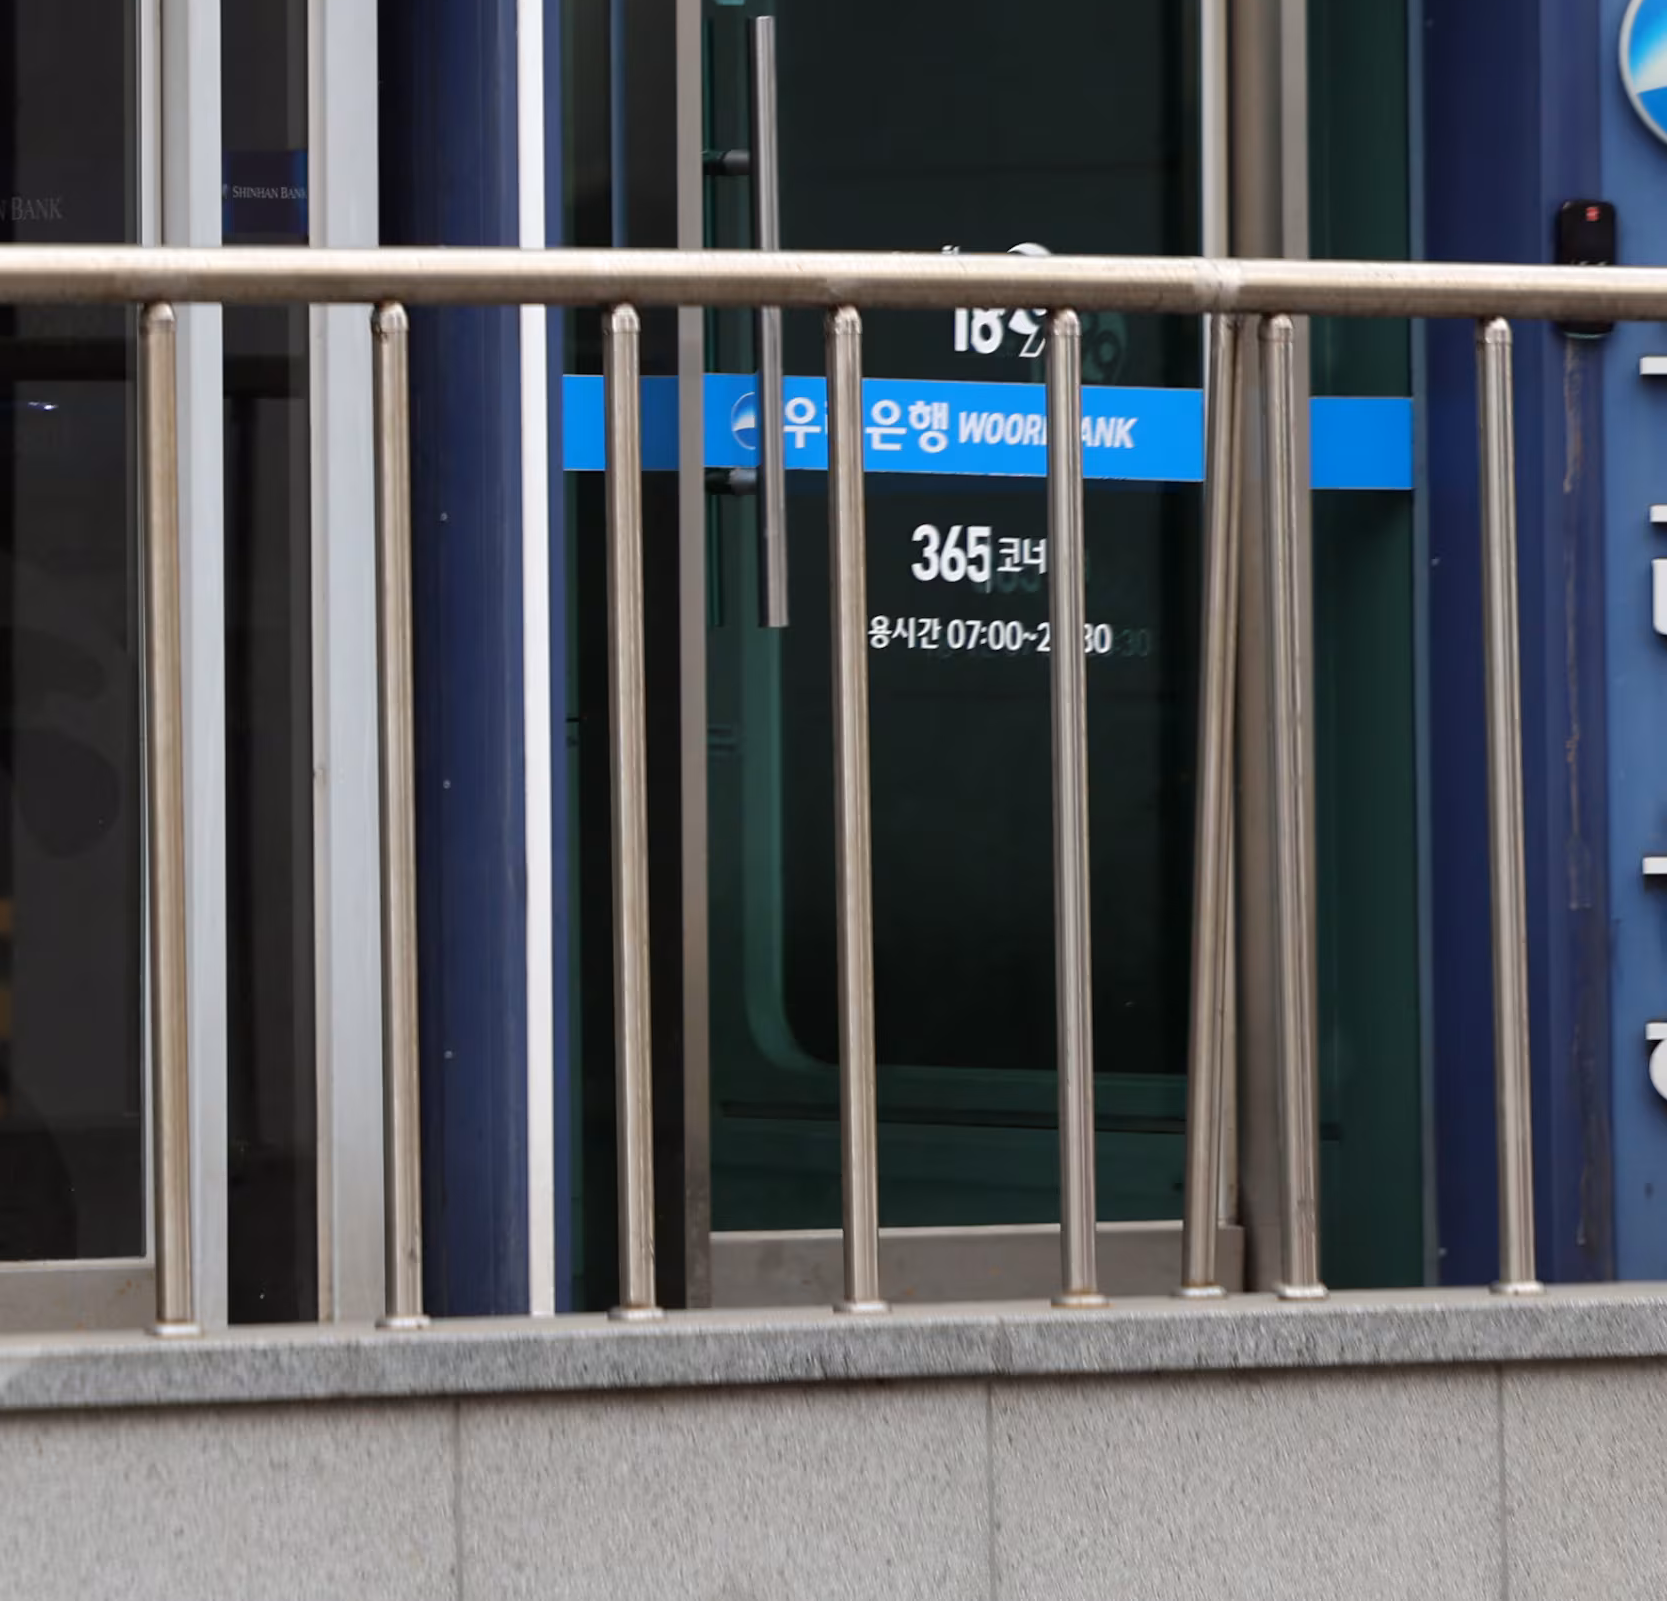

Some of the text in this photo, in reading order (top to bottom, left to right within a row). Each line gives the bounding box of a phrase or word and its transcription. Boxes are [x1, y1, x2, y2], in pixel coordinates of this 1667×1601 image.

[783, 396, 950, 454] 우은행
[1081, 416, 1138, 449] ANK
[911, 524, 992, 583] 365
[867, 614, 943, 650] 용시간
